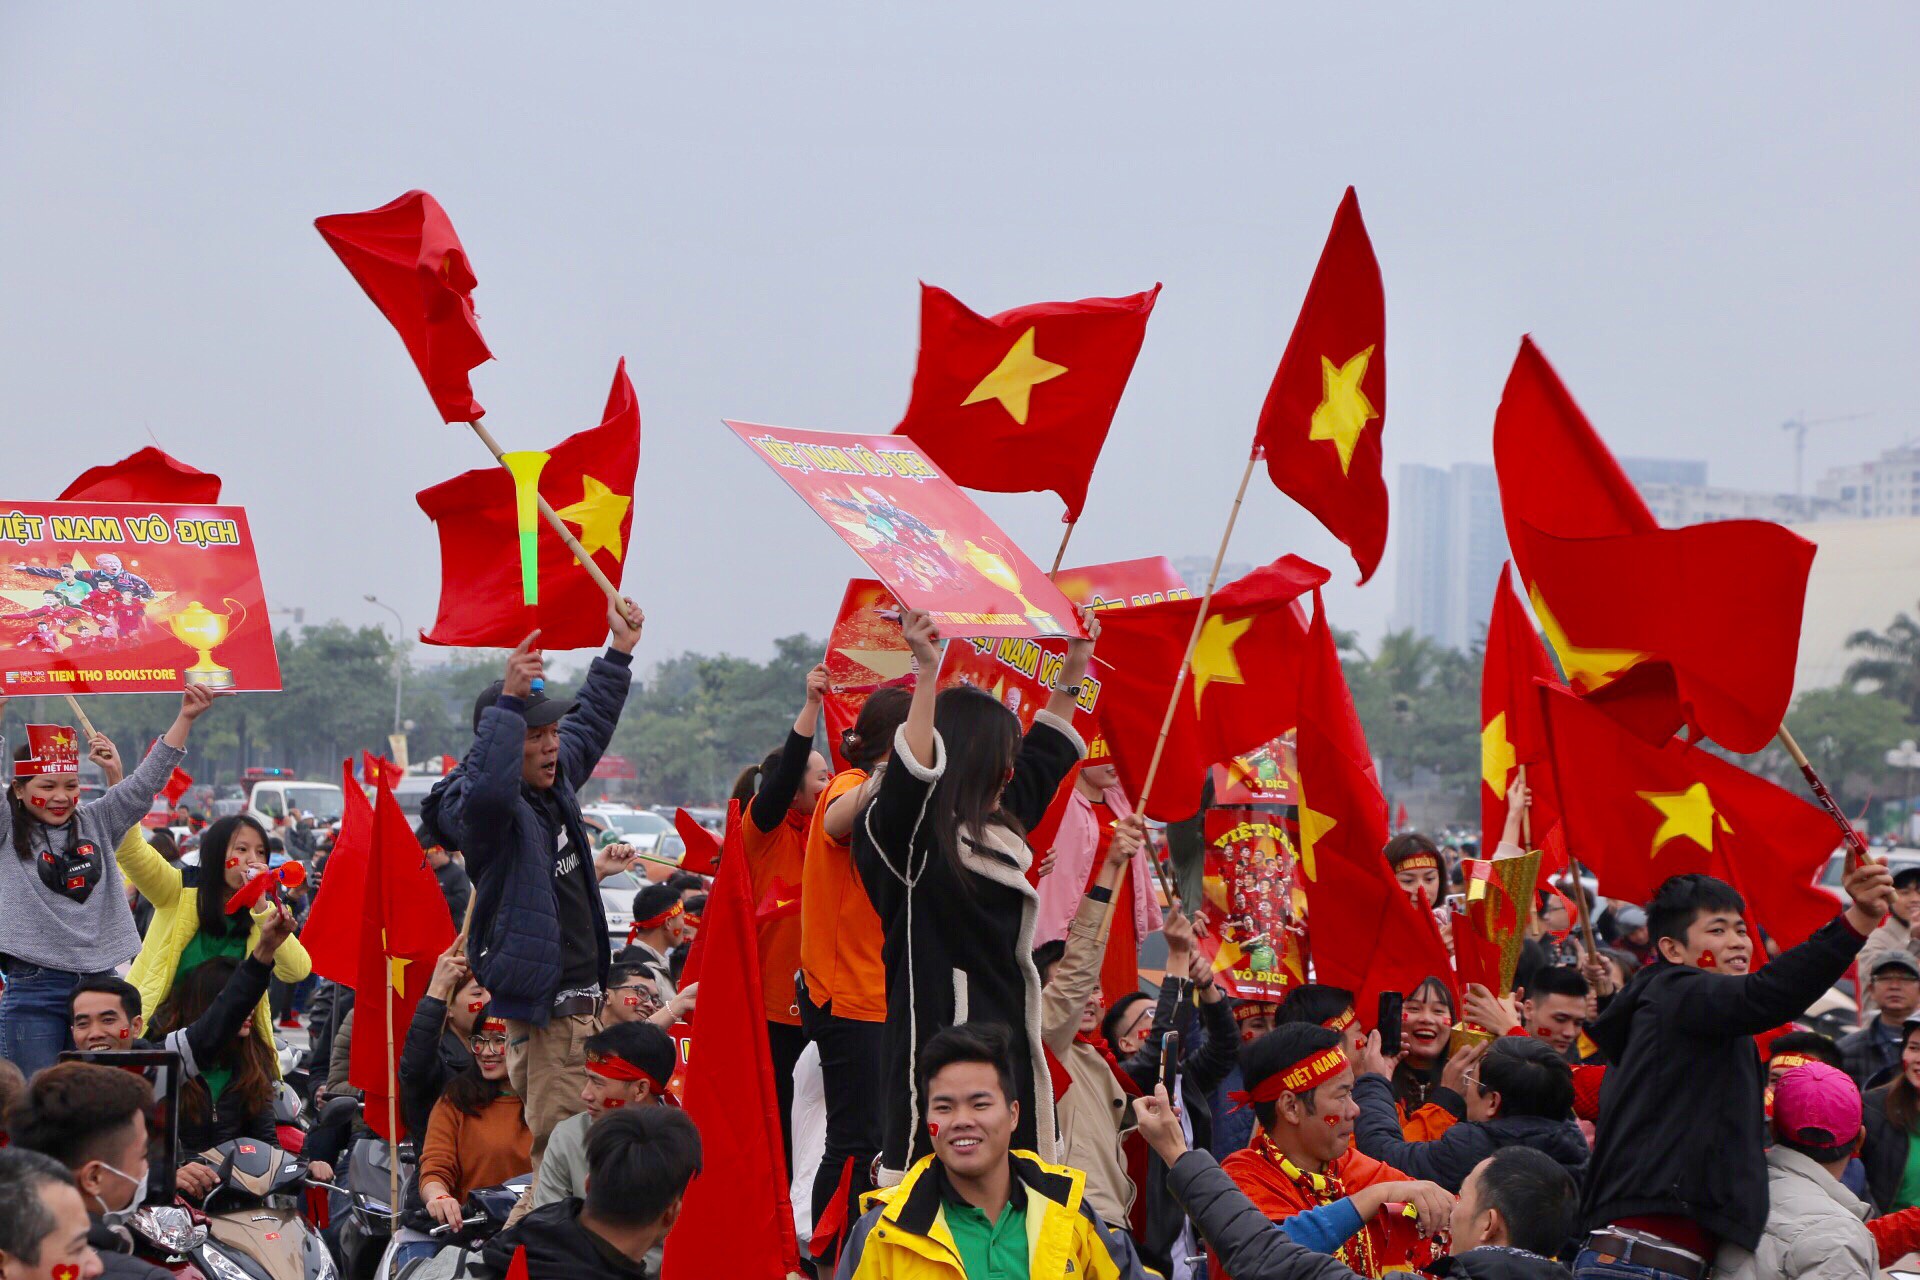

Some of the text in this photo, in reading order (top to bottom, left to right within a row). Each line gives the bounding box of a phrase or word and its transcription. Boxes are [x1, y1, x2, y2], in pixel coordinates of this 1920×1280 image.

[749, 434, 940, 483] VIỆT NAM VÔ ĐỊCH
[49, 516, 125, 542] NAM
[125, 513, 170, 543] VÔ
[175, 518, 241, 548] ĐỊCH
[20, 675, 46, 683] BOOKS
[47, 669, 177, 682] TIEN THO BOOKSTORE
[997, 636, 1042, 680] NAM
[1076, 674, 1102, 715] CH
[42, 763, 62, 774] VIỆT
[1213, 821, 1266, 849] VIỆT
[1232, 967, 1289, 986] VÔ ĐỊCH
[1282, 1050, 1341, 1090] VIỆT NAM
